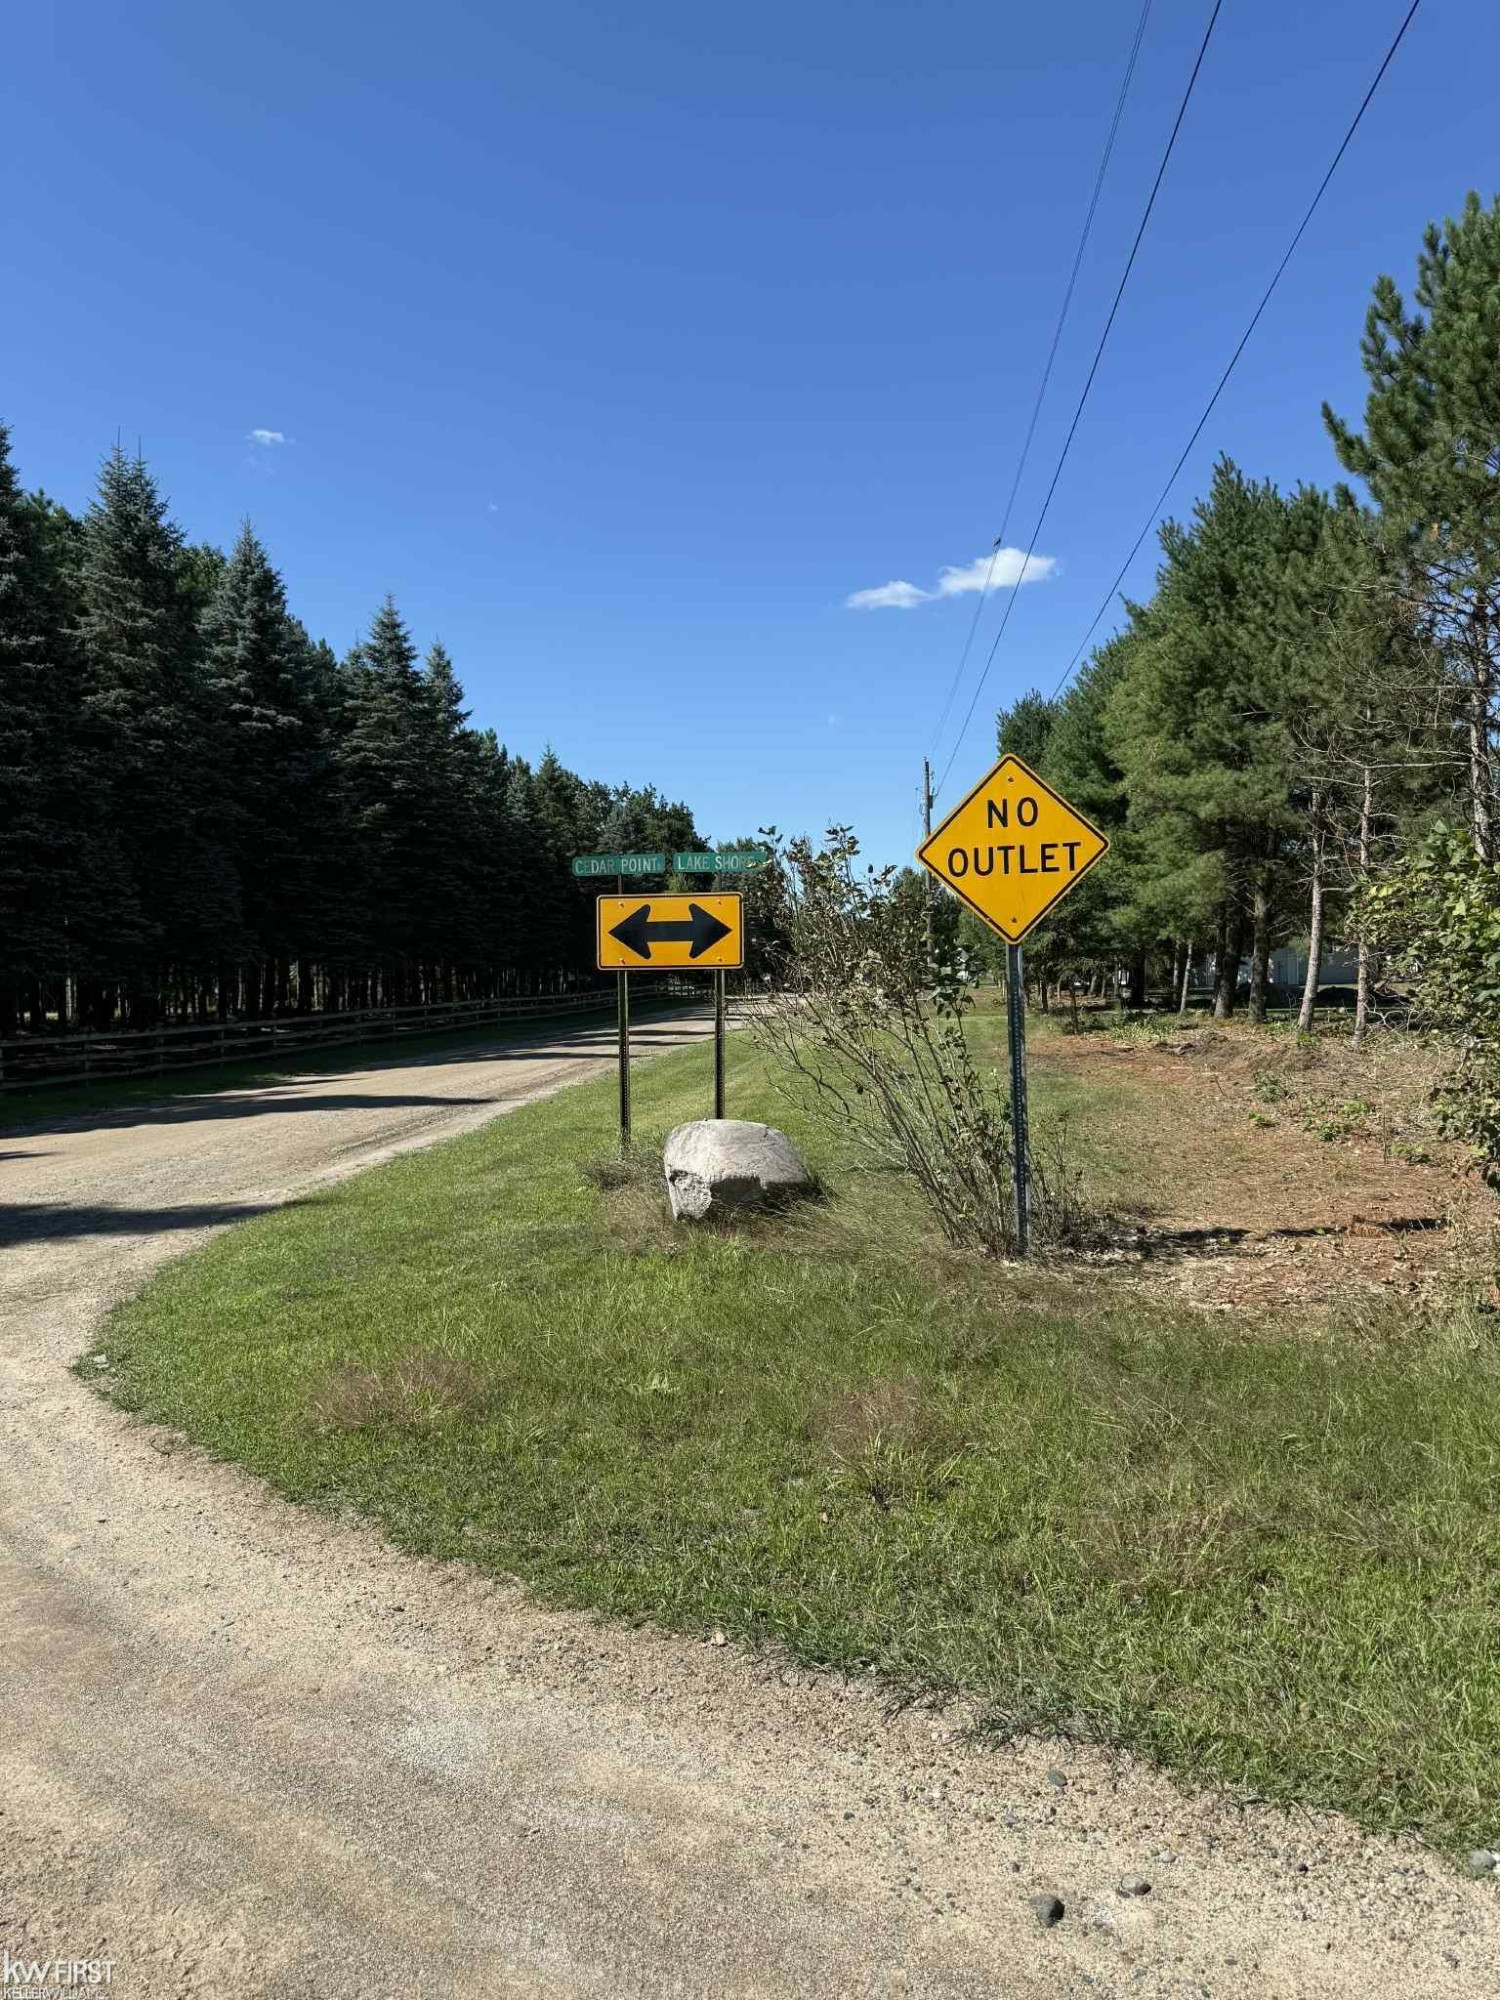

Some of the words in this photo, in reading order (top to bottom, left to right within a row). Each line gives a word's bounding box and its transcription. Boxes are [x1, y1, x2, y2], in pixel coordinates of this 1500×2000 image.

[987, 797, 1038, 829] NO
[575, 859, 616, 875] CEDAR
[622, 857, 658, 872] POINT
[677, 856, 710, 870] LAKE
[947, 842, 1082, 878] OUTLET
